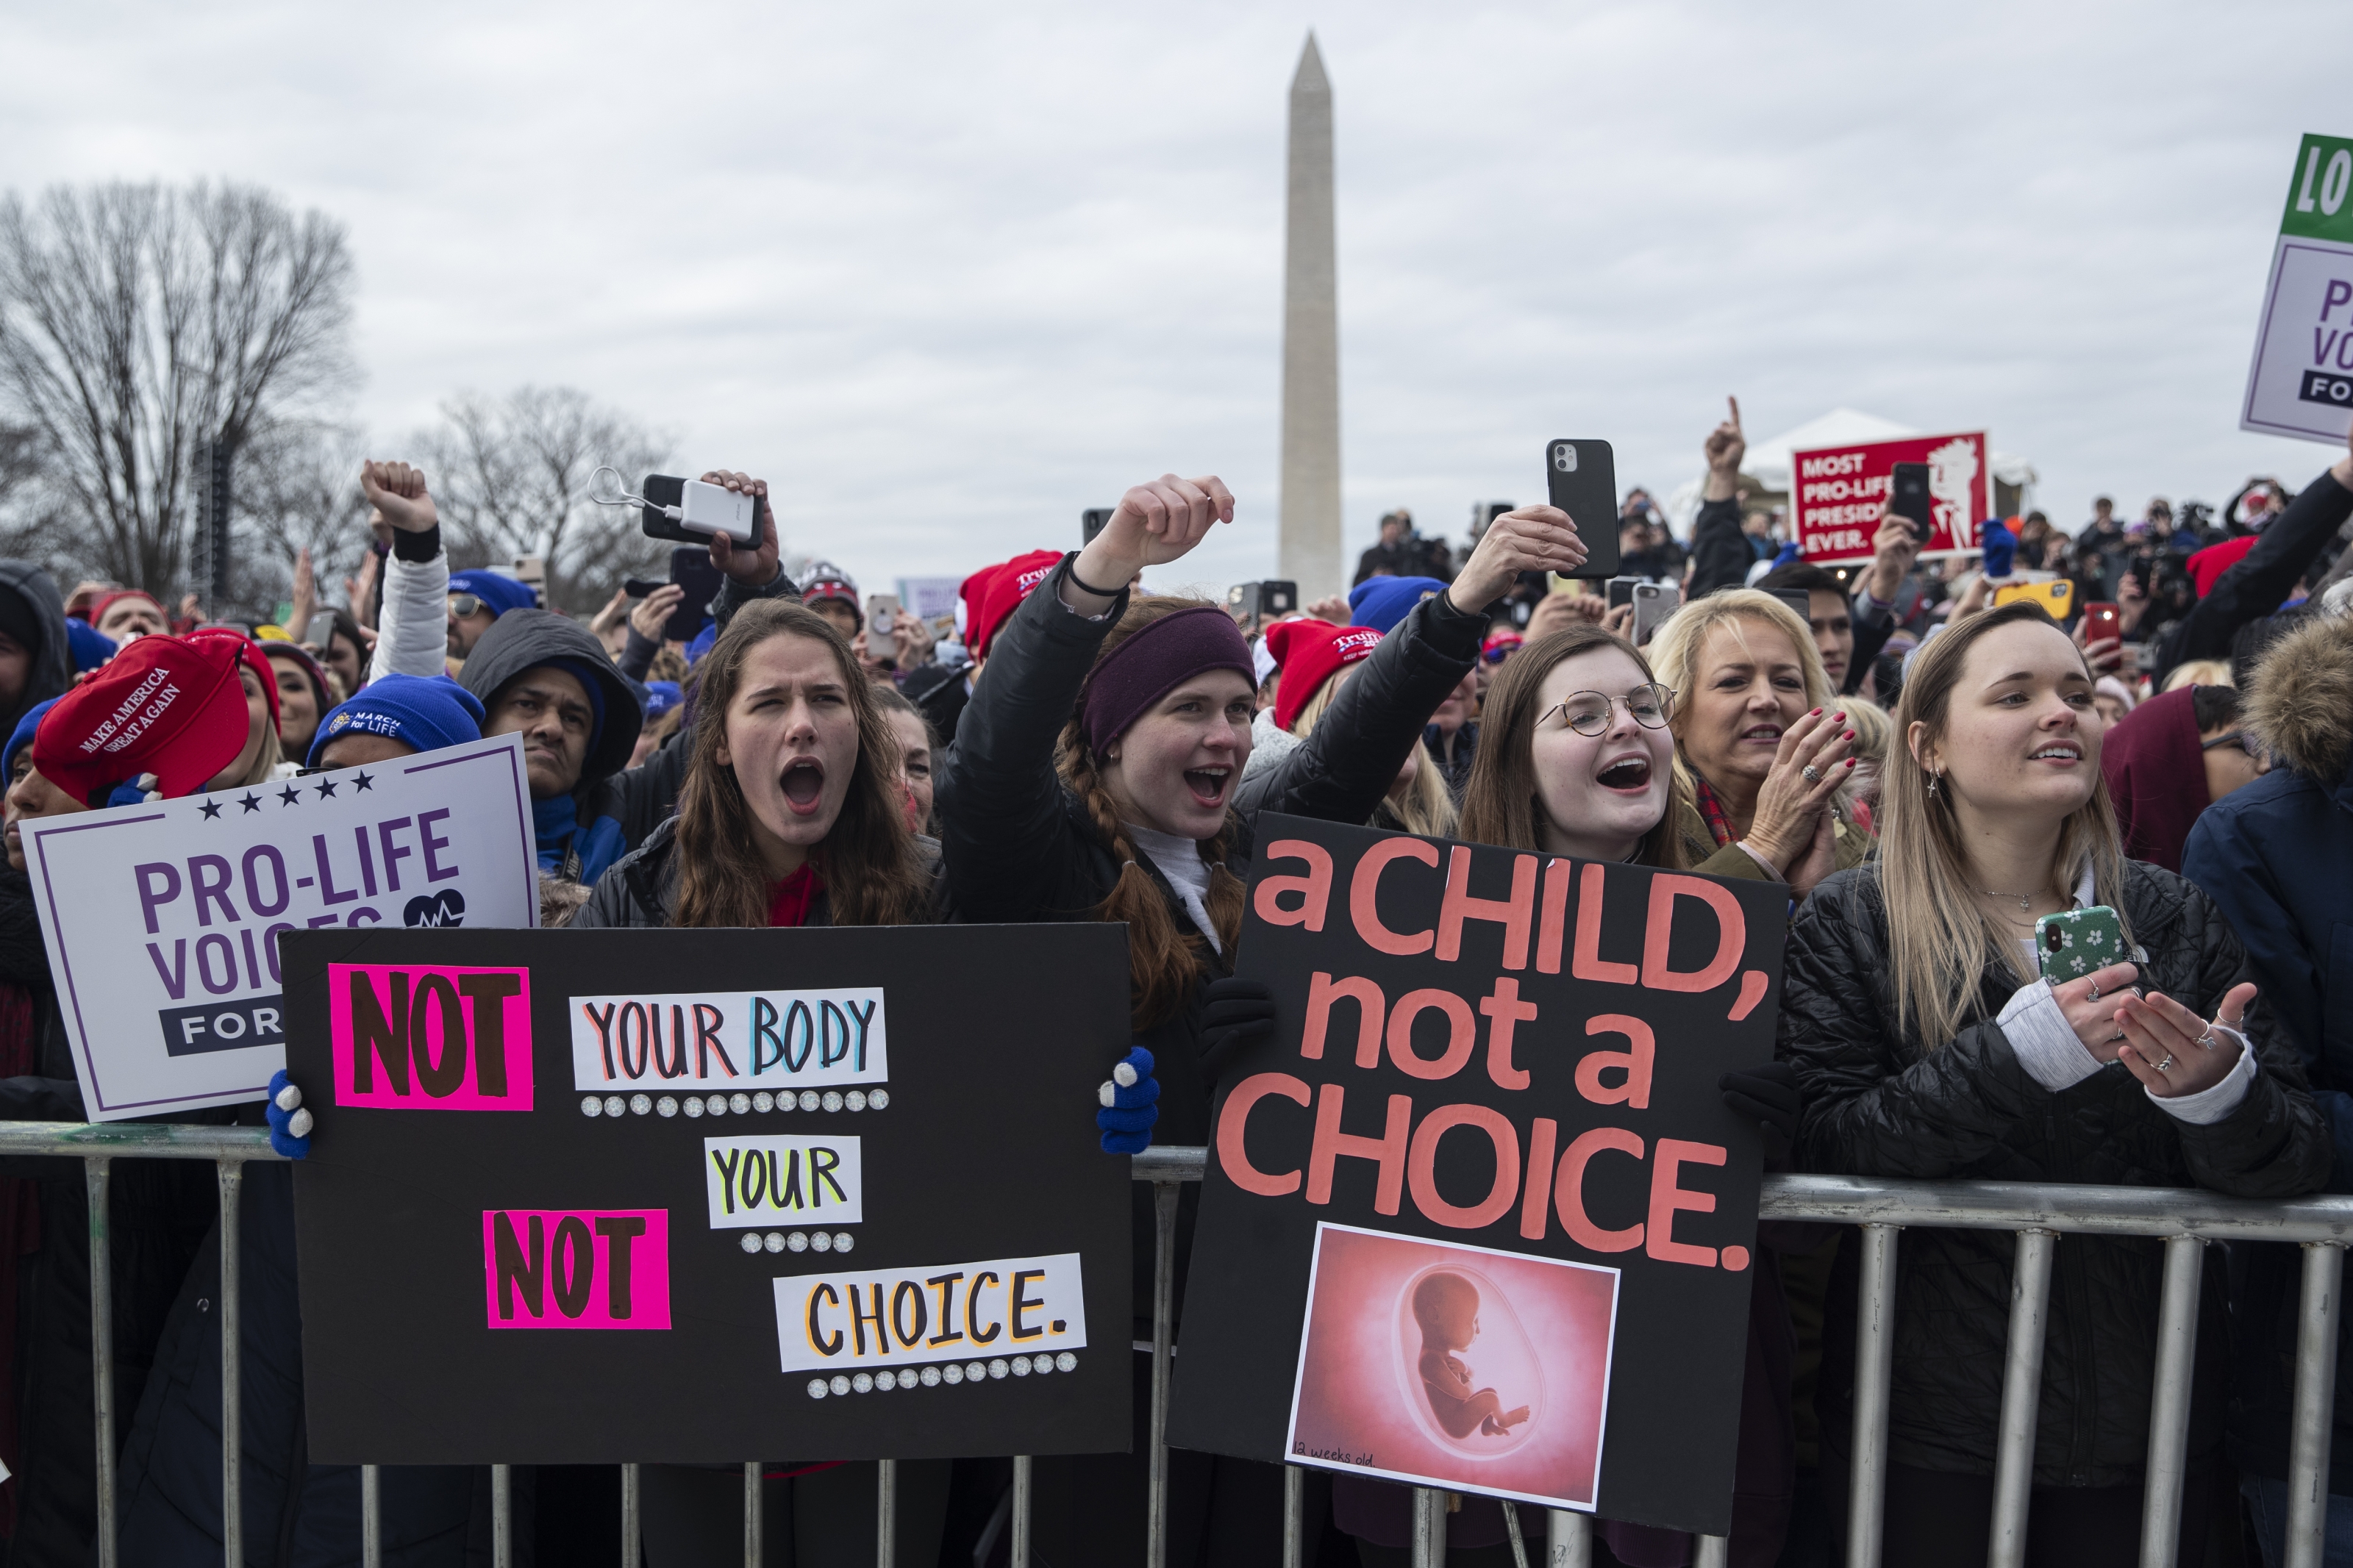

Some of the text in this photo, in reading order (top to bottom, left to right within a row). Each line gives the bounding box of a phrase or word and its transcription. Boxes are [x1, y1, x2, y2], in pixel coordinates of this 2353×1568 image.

[2296, 146, 2353, 216] LO
[2320, 279, 2353, 326] P
[2310, 376, 2353, 403] FO
[1802, 453, 1866, 479] MOST
[1804, 501, 1887, 529] PRESID
[1806, 529, 1868, 554] EVER.
[79, 667, 170, 753] MAKE AMERICA
[103, 683, 181, 752] GREAT AGAIN
[350, 720, 396, 737] for LIFE
[355, 712, 401, 728] MARCH
[135, 808, 459, 933] PRO-LIFE
[147, 906, 382, 999] VOIC
[1254, 837, 1768, 1021] a CHILD,
[181, 1007, 283, 1043] FOR
[349, 971, 876, 1098] NOT YOUR BODY
[1300, 971, 1655, 1109] not a
[710, 1147, 848, 1215] YOUR
[1216, 1073, 1751, 1271] CHOICE.
[493, 1211, 646, 1320] NOT
[804, 1269, 1068, 1359] CHOICE.
[1293, 1441, 1376, 1468] 12 weeks old.
